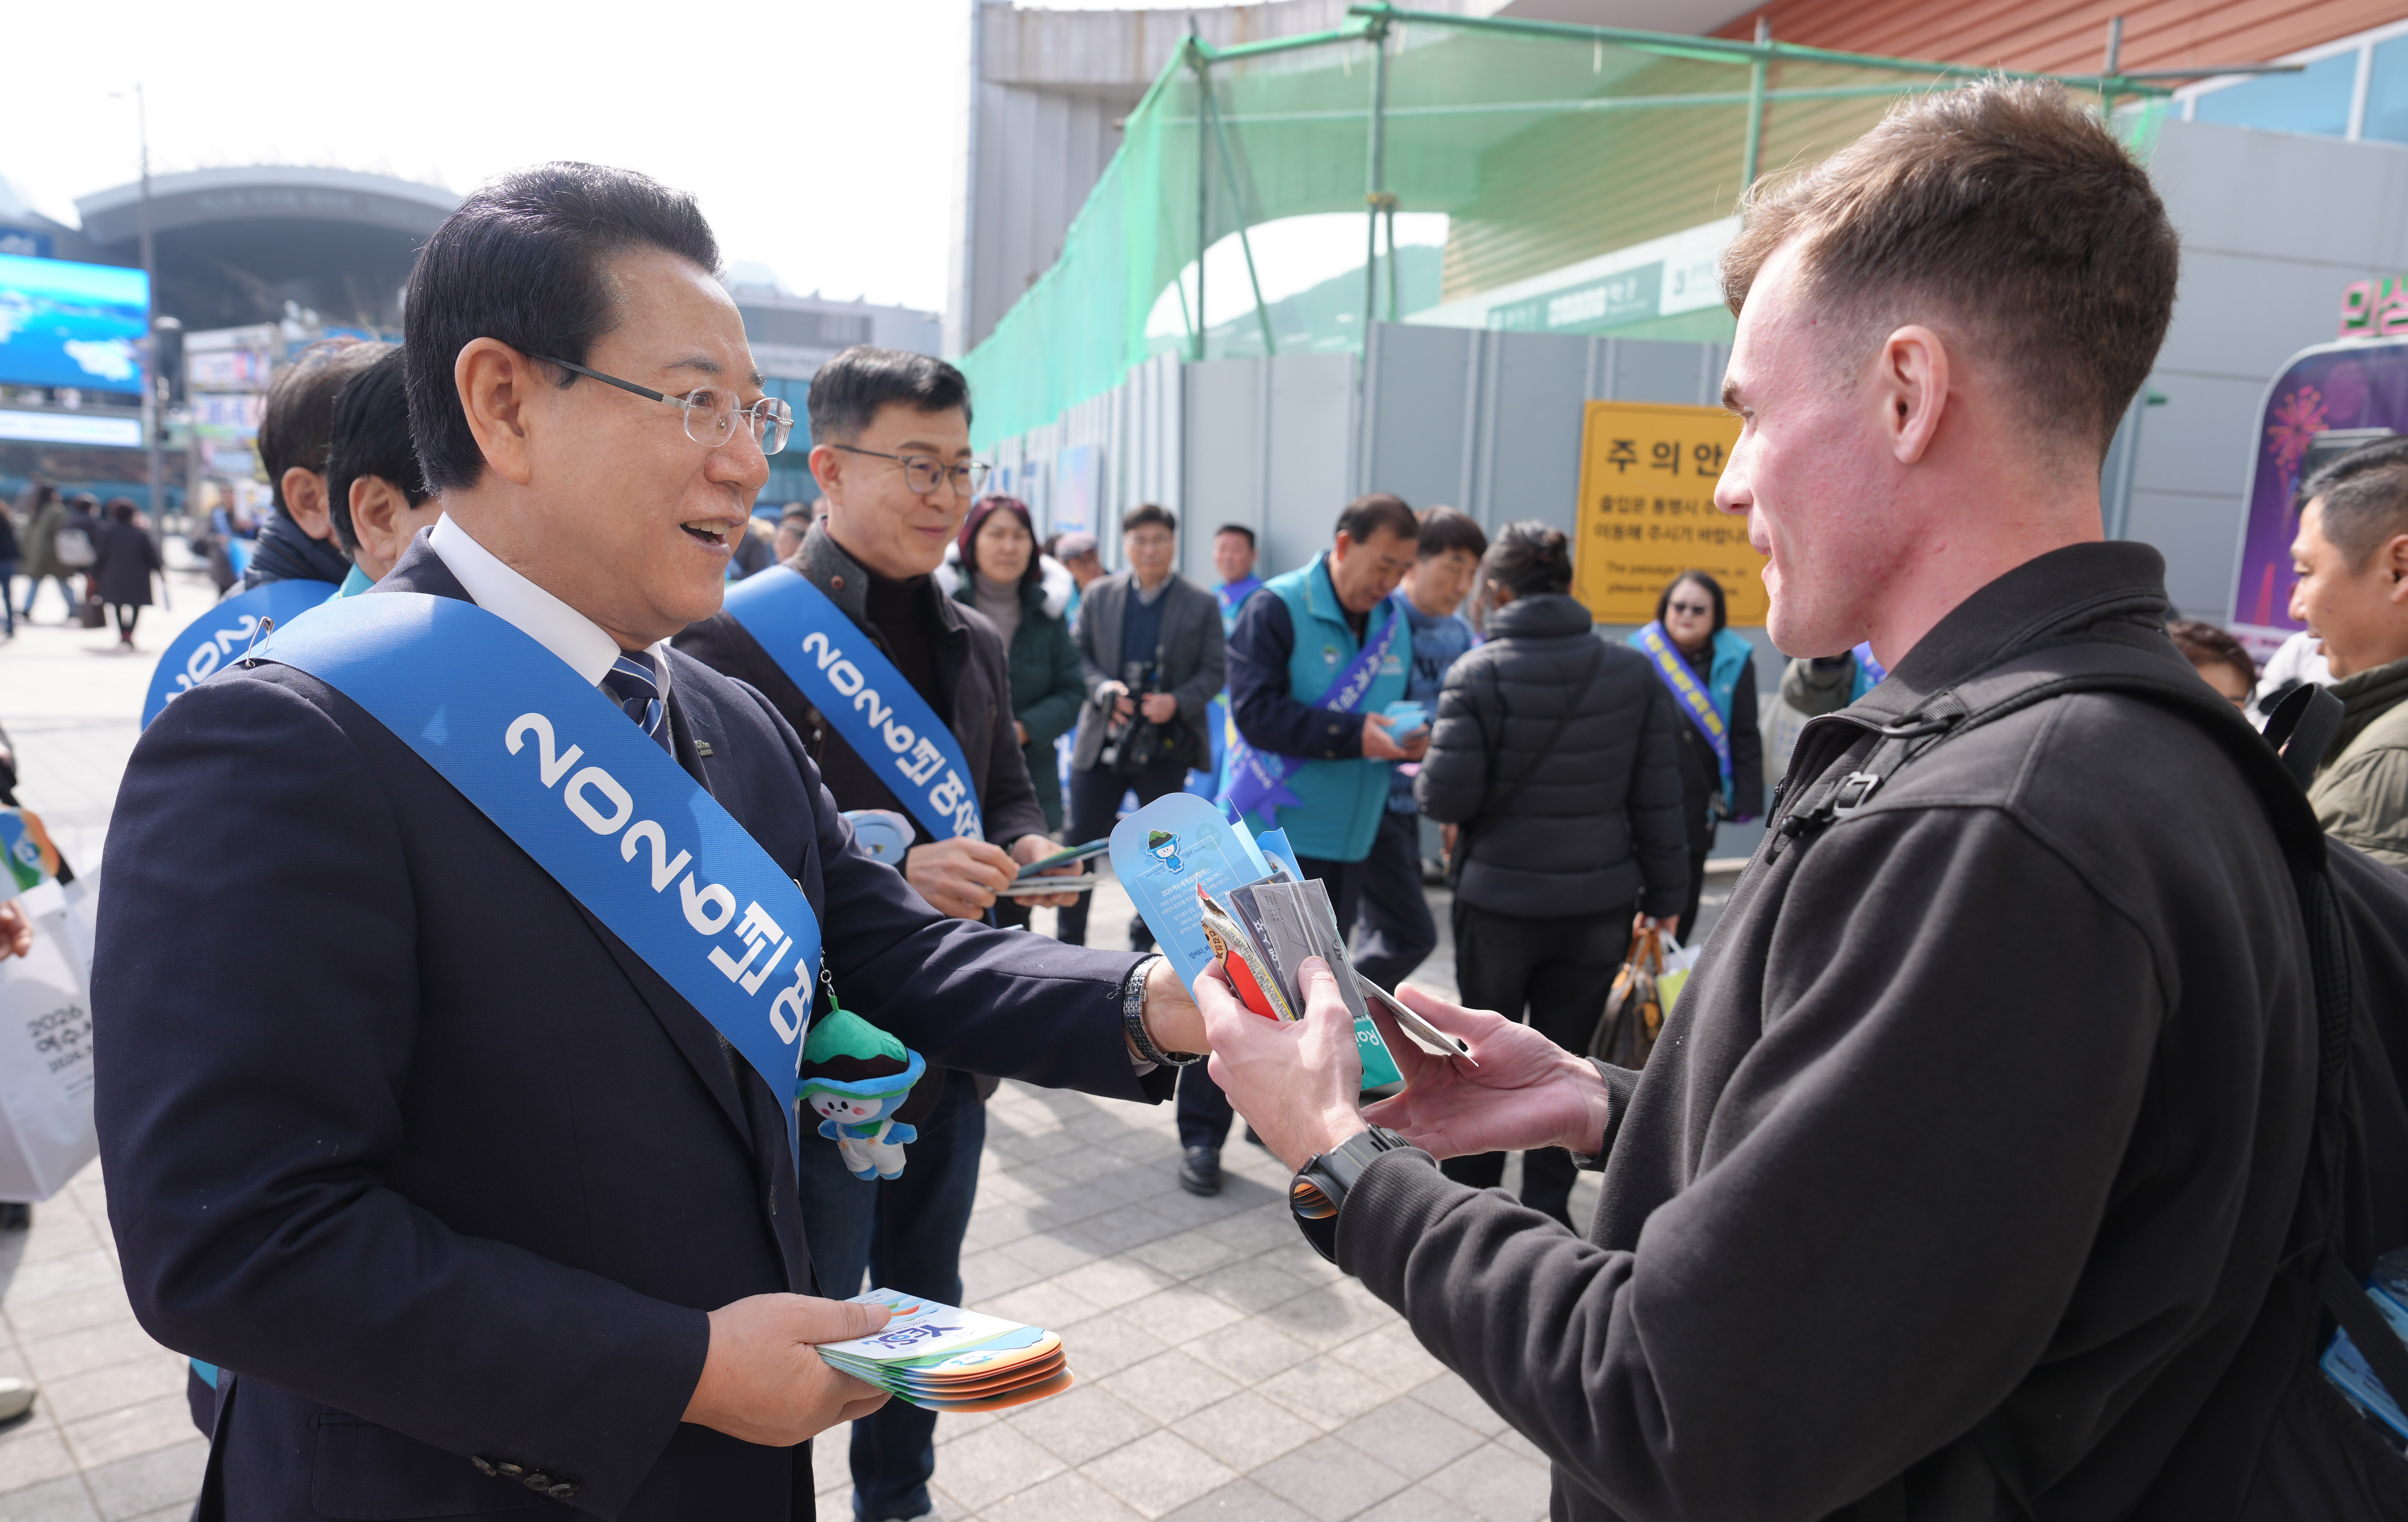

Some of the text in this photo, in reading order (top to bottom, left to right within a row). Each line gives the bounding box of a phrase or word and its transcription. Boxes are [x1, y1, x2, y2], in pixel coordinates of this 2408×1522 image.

[1647, 524, 1695, 543] 주시기
[1161, 887, 1174, 897] 2026
[1171, 867, 1212, 891] 여수세계섬박람회는
[1209, 930, 1223, 960] 건강설계
[1354, 1028, 1380, 1049] Rai
